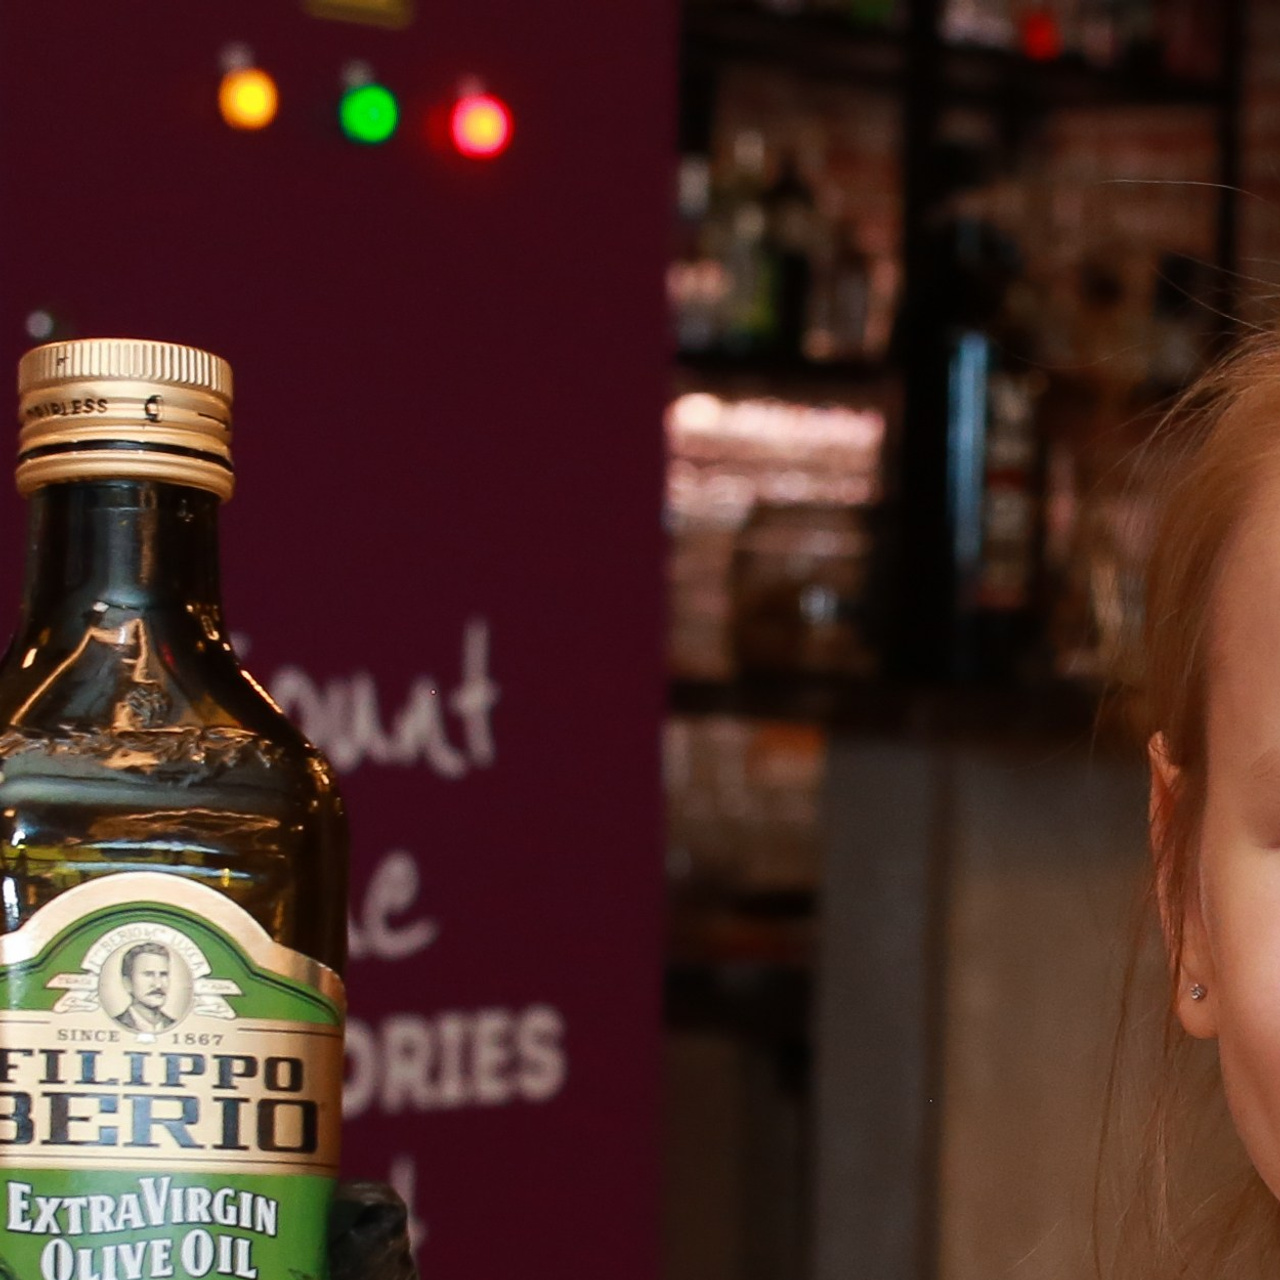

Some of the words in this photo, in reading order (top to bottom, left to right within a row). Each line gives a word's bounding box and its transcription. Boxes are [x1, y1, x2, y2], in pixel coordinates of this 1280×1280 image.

[57, 1029, 120, 1042] SINCE
[172, 1033, 224, 1047] 1867
[0, 1048, 304, 1092] FILIPPO
[180, 1228, 259, 1280] OIL
